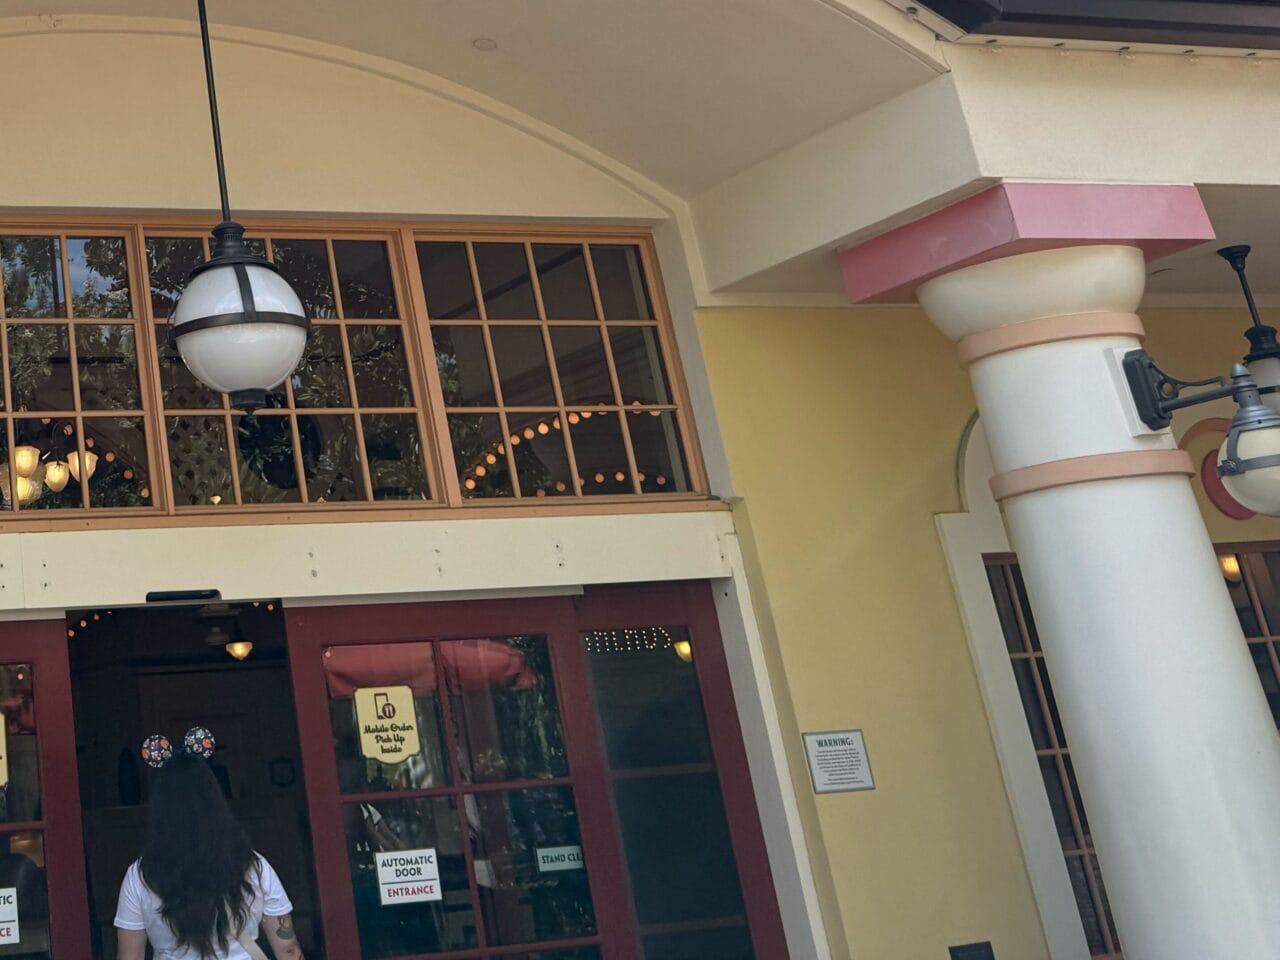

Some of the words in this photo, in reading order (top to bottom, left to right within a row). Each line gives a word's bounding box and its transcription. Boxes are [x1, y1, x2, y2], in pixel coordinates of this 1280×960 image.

[363, 724, 389, 734] Mobile
[390, 723, 414, 732] Order
[375, 735, 392, 744] Pick
[393, 734, 405, 745] Up
[816, 737, 854, 748] WARNING:
[381, 745, 402, 753] Inside
[381, 855, 434, 868] AUTOMATIC
[542, 854, 566, 864] STAND
[395, 867, 423, 878] DOOR
[387, 885, 435, 898] ENTRANCE
